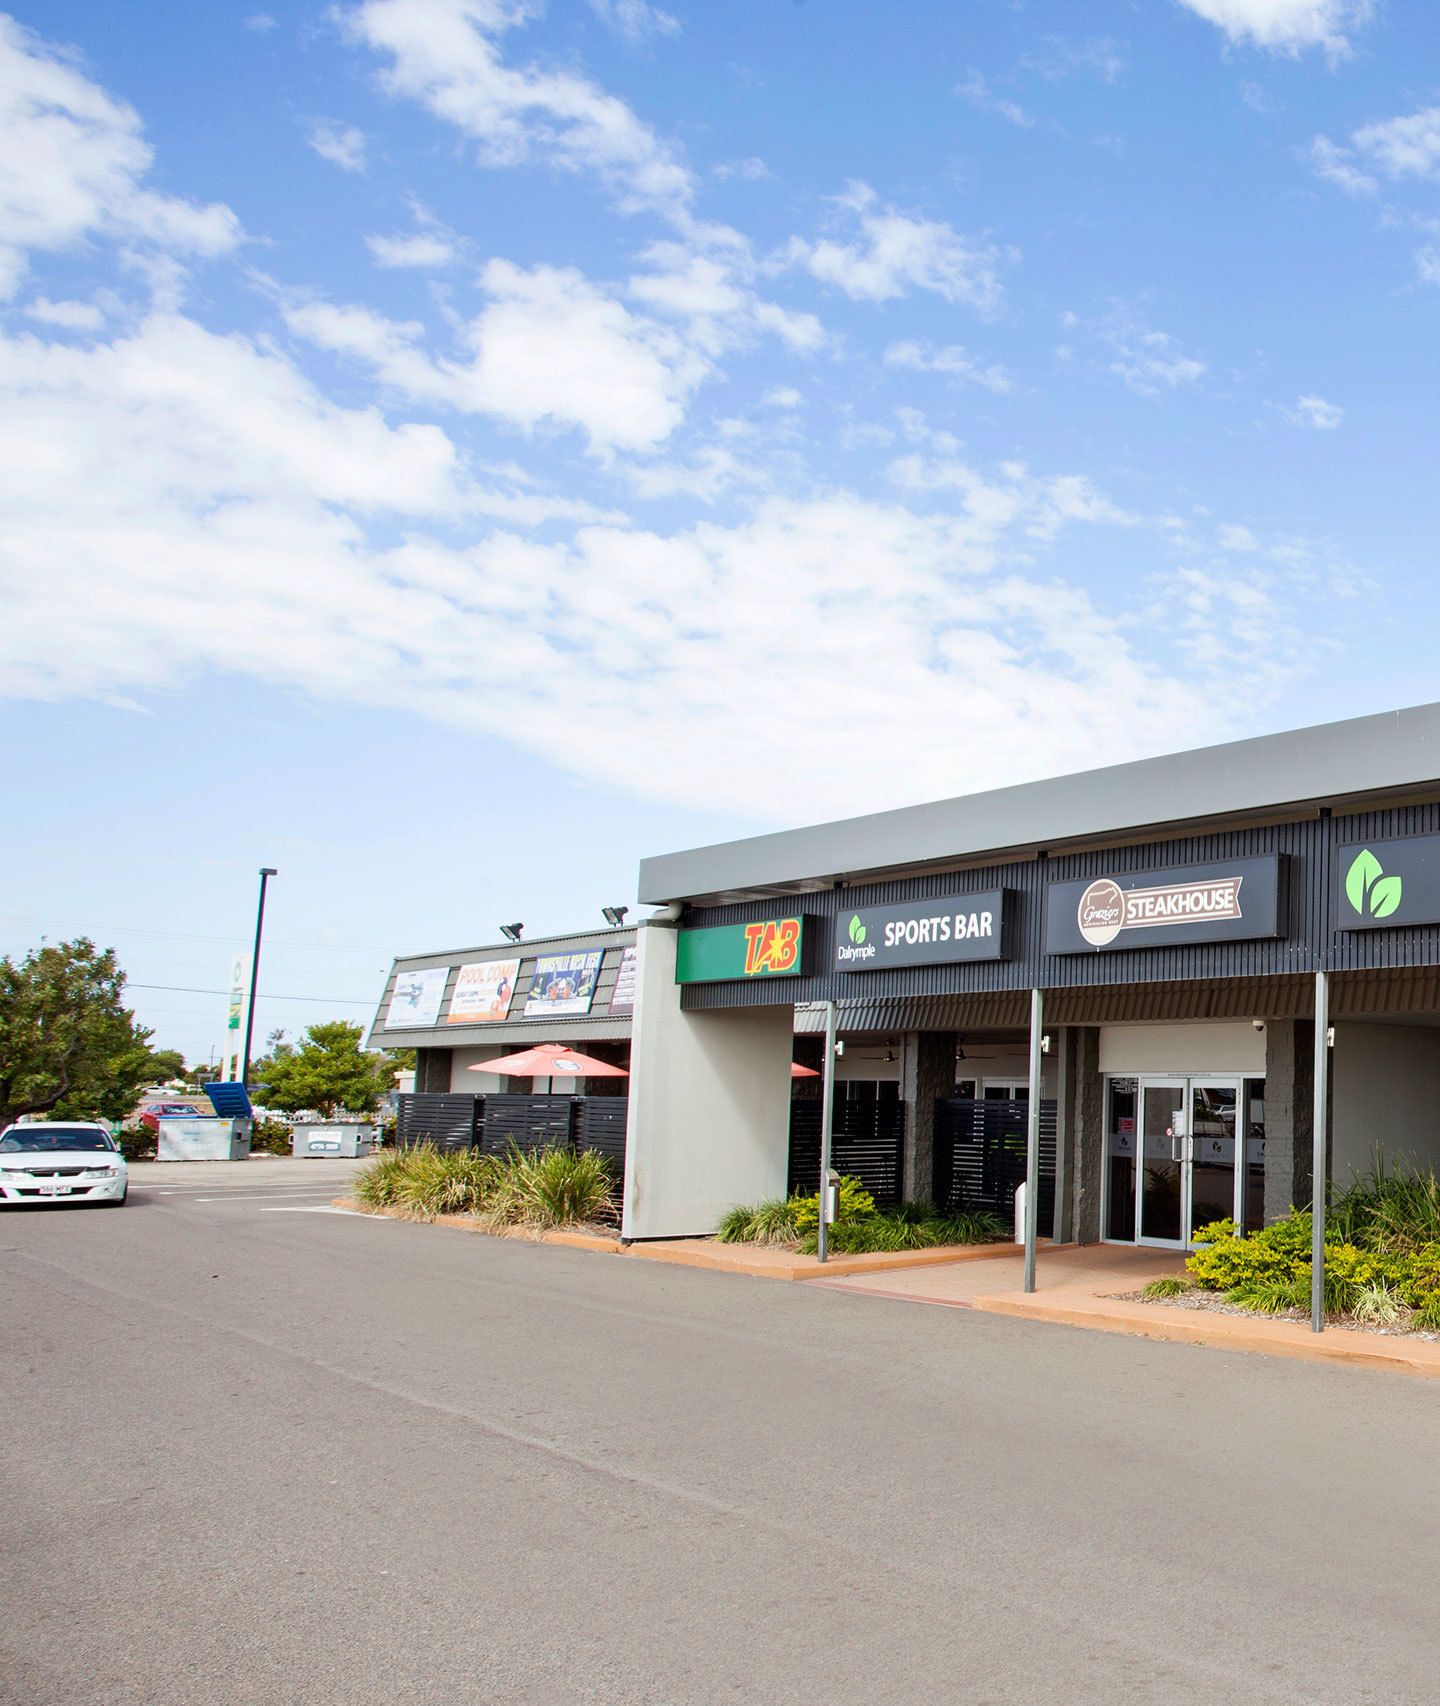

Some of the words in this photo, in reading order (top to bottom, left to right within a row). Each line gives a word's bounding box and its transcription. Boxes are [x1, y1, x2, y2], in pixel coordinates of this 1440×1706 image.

[1127, 888, 1234, 919] STEAKHOUSE
[884, 916, 951, 947] SPORTS
[954, 911, 993, 940] BAR
[744, 919, 800, 975] TAB
[838, 944, 876, 961] Dalrymple
[459, 967, 485, 985] POOL
[487, 963, 517, 982] COMP
